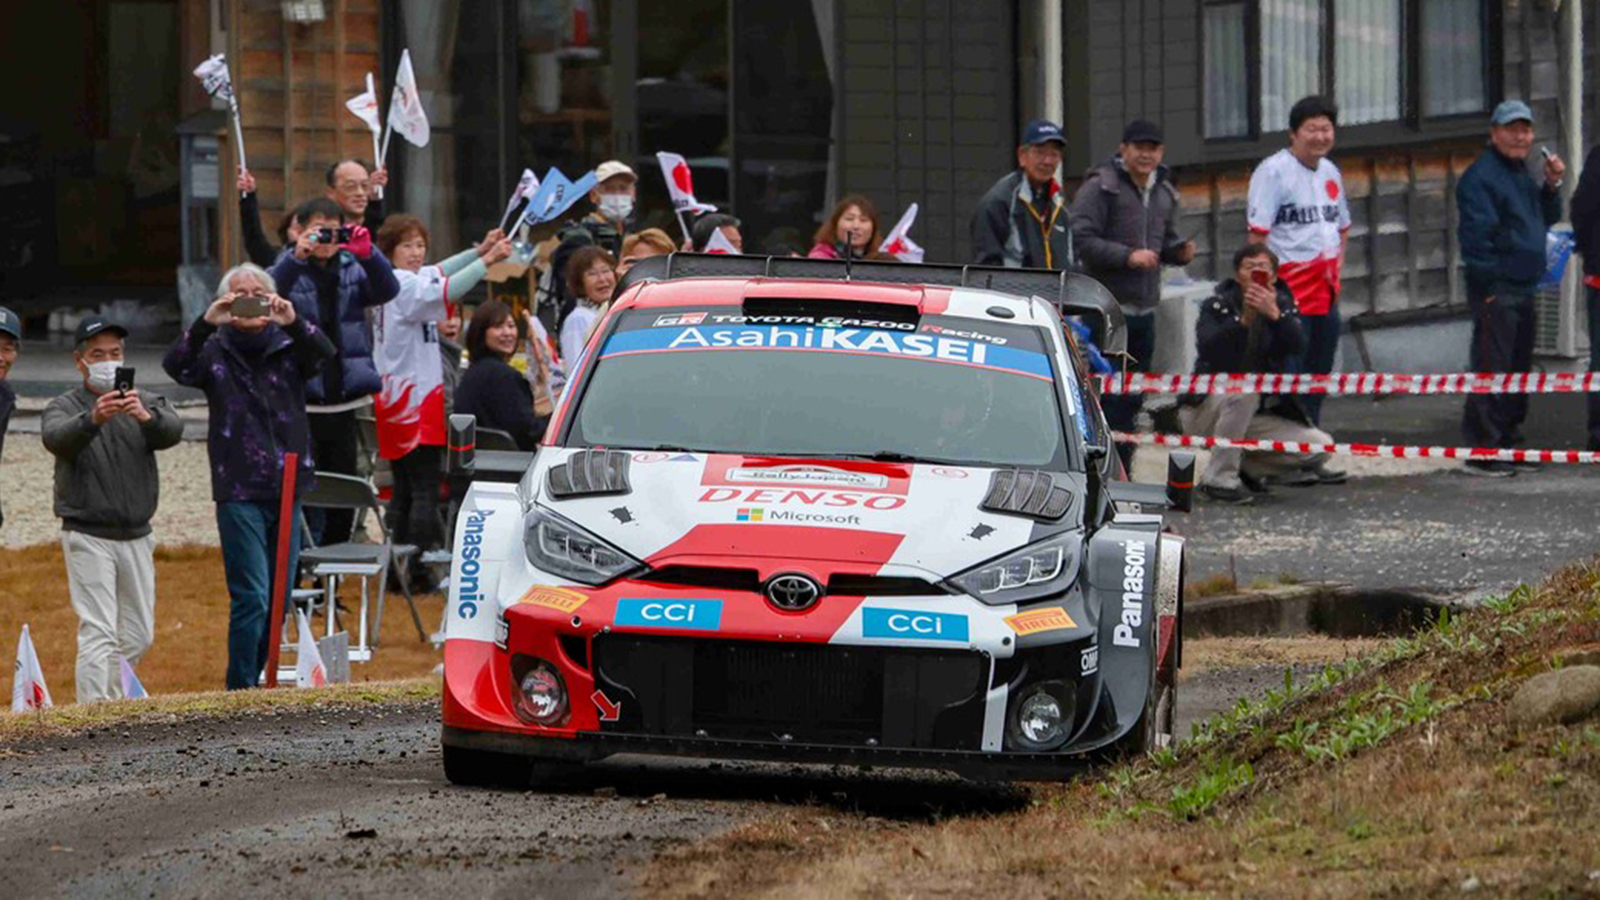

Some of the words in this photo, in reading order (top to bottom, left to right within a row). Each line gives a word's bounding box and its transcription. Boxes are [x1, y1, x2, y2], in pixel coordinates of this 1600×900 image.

[656, 313, 703, 327] GR
[711, 314, 816, 325] TOYOTA
[821, 316, 917, 332] GAZOO
[920, 324, 1008, 345] Racing
[697, 487, 907, 511] DENSO
[769, 510, 862, 525] Microsoft
[457, 509, 496, 620] Panasonic
[1009, 610, 1069, 631] PIRELLI
